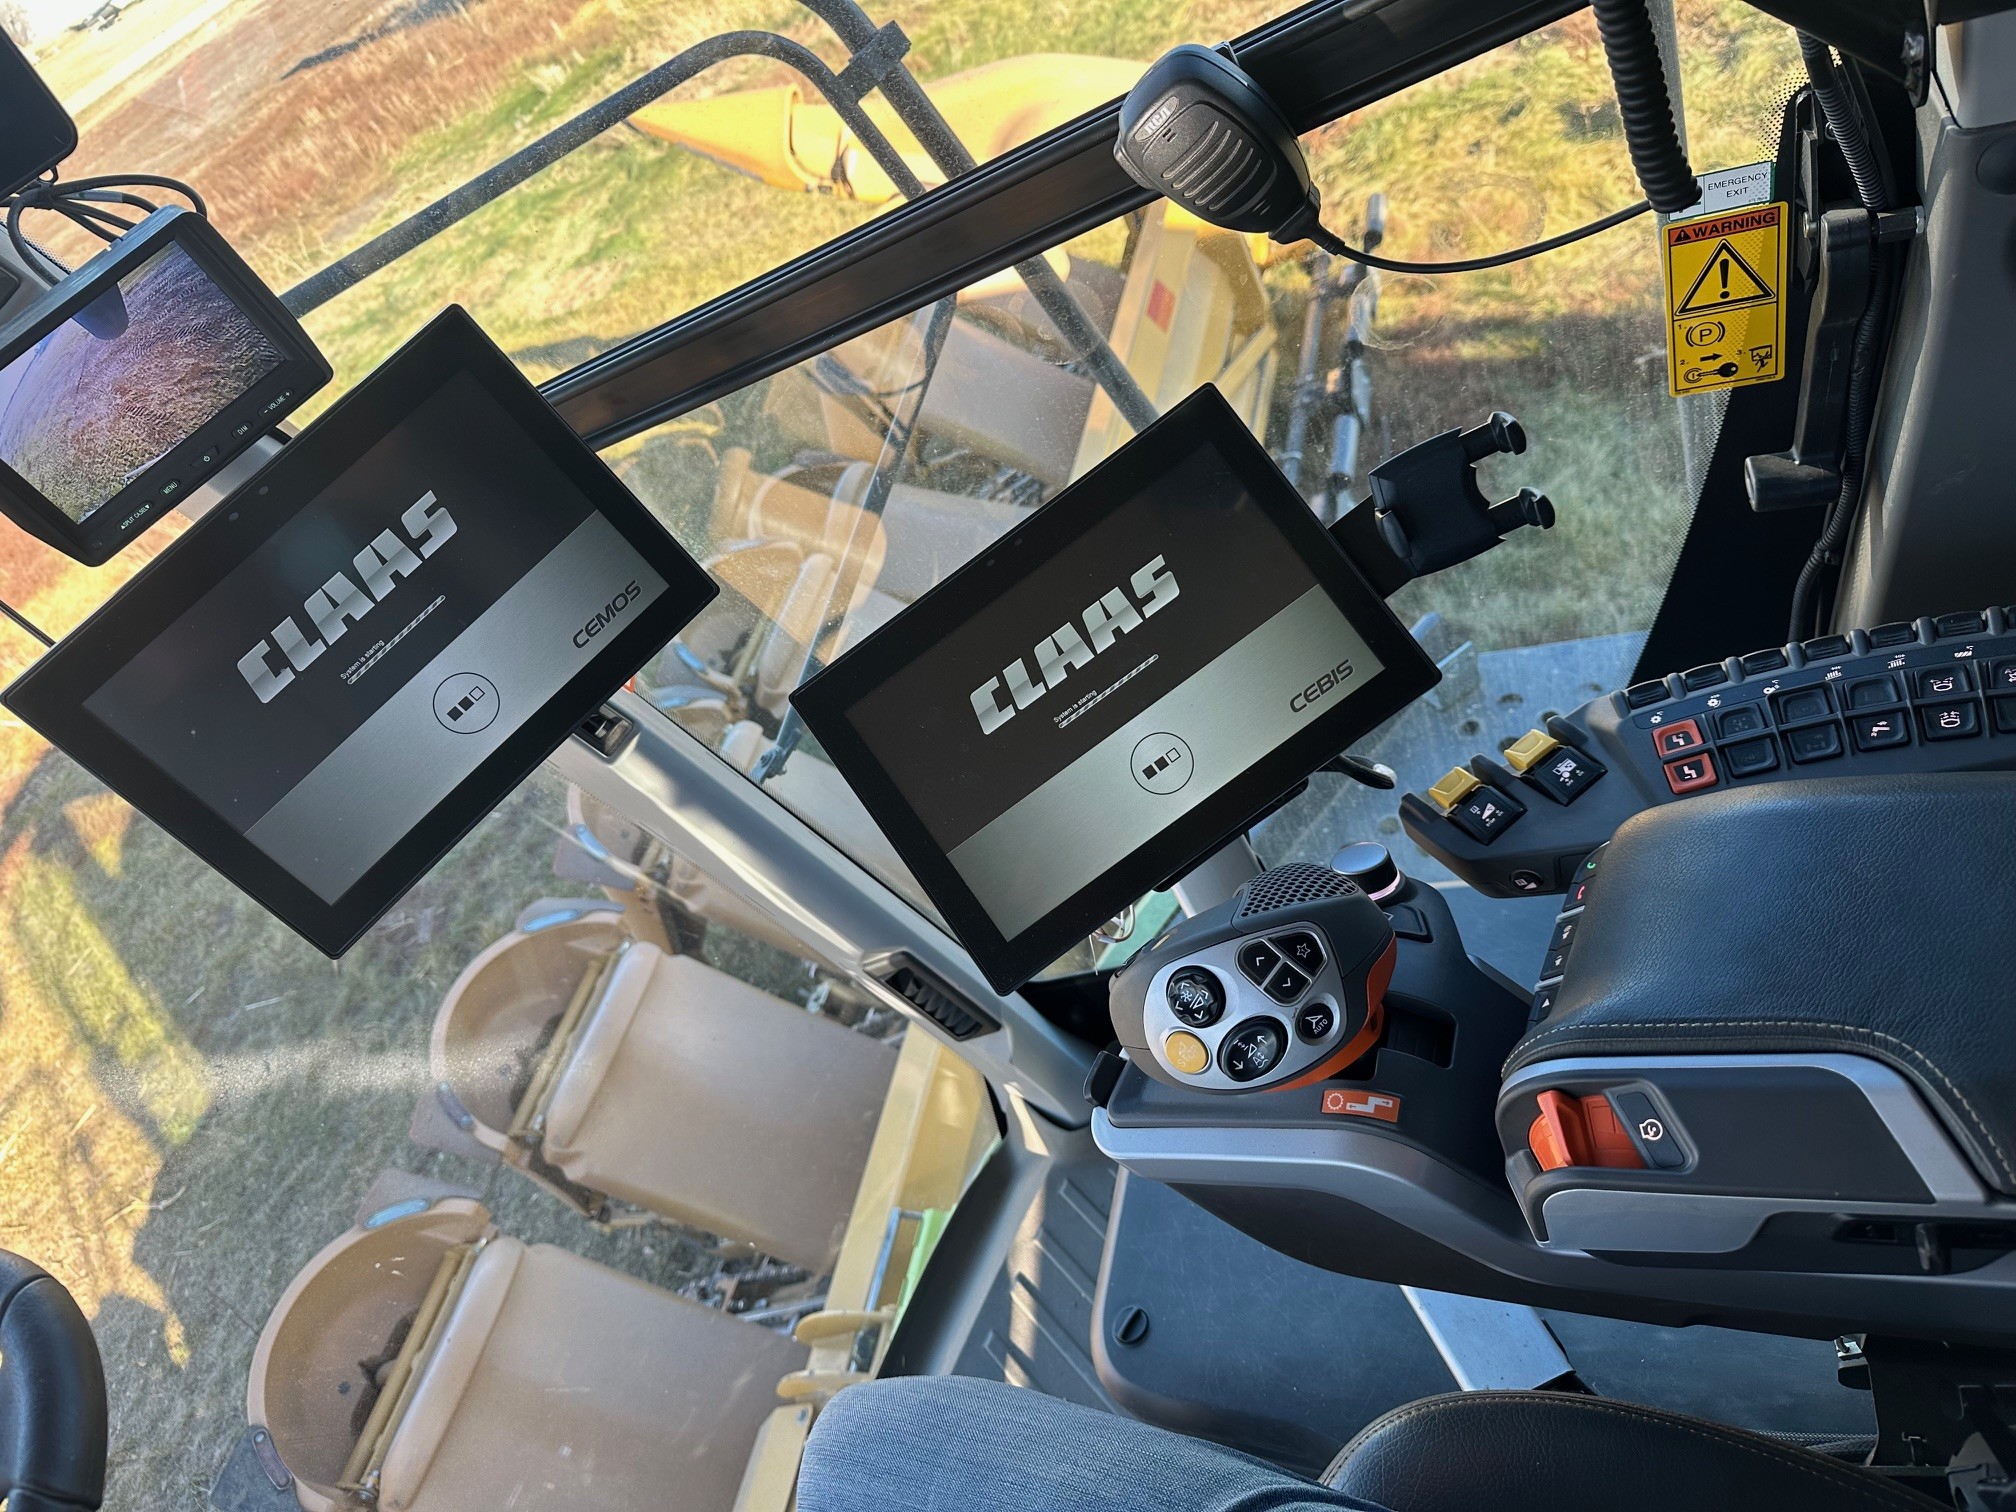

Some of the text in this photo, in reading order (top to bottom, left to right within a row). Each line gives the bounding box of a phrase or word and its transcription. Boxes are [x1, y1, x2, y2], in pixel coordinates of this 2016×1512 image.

[1144, 106, 1171, 135] RCA
[1707, 171, 1768, 191] EMERGENCY
[1726, 186, 1749, 198] EXIT
[1692, 212, 1775, 239] WARNING
[1699, 328, 1713, 343] P
[268, 394, 286, 411] VOLUME
[237, 424, 249, 436] DIM
[162, 481, 178, 495] MENU
[237, 490, 458, 704] CLAAS
[572, 580, 642, 650] CEMOS
[970, 554, 1180, 736] CLAAS
[340, 660, 361, 681] System
[364, 640, 386, 658] starting
[1289, 658, 1355, 714] CEBIS
[1053, 707, 1074, 723] System
[1077, 690, 1098, 706] starting
[1313, 1018, 1329, 1035] AUTO
[1177, 1044, 1198, 1068] STOP
